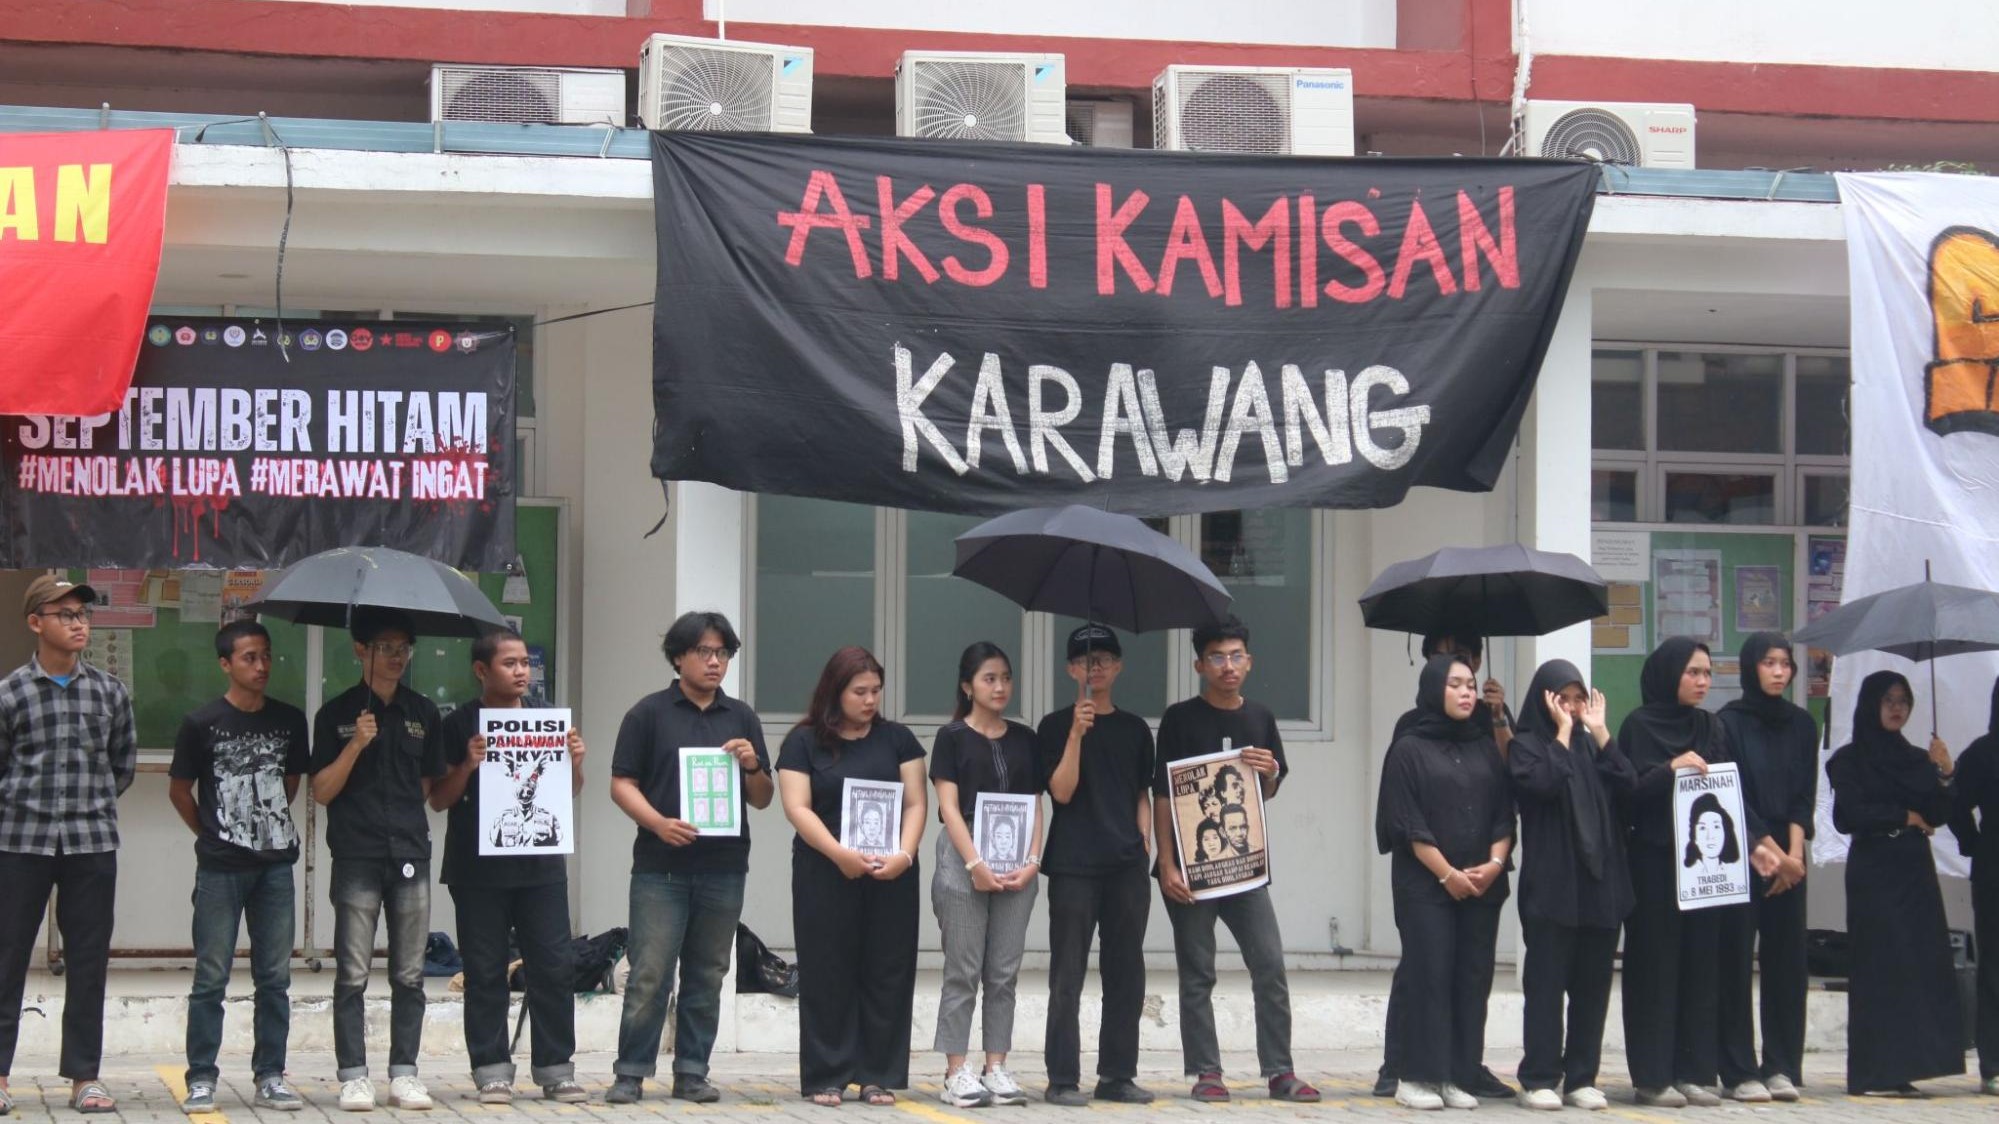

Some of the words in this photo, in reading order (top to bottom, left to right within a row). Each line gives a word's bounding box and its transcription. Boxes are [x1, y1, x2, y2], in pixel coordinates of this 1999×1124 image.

[1296, 79, 1345, 89] Panasonic
[1648, 126, 1688, 134] SHARP
[776, 169, 1048, 289] AKSI
[1095, 183, 1520, 309] KAMISAN
[18, 386, 313, 452] SEPTEMBER
[327, 389, 488, 454] HITAM
[894, 346, 1431, 484] KARAWANG
[18, 454, 165, 496] #MENOLAK
[171, 456, 242, 497] LUPA
[250, 457, 405, 500] #MERAWAT
[411, 459, 489, 501] INGAT
[487, 720, 565, 732] POLISI
[486, 734, 565, 748] PAHLAWAN
[1173, 765, 1207, 785] MENOLAK
[1176, 781, 1196, 796] LUPA
[1679, 775, 1735, 793] MARSINAH
[1697, 874, 1727, 885] TRAGEDI
[1690, 886, 1697, 897] 8
[1699, 885, 1713, 896] MEI
[1715, 882, 1735, 894] 1993
